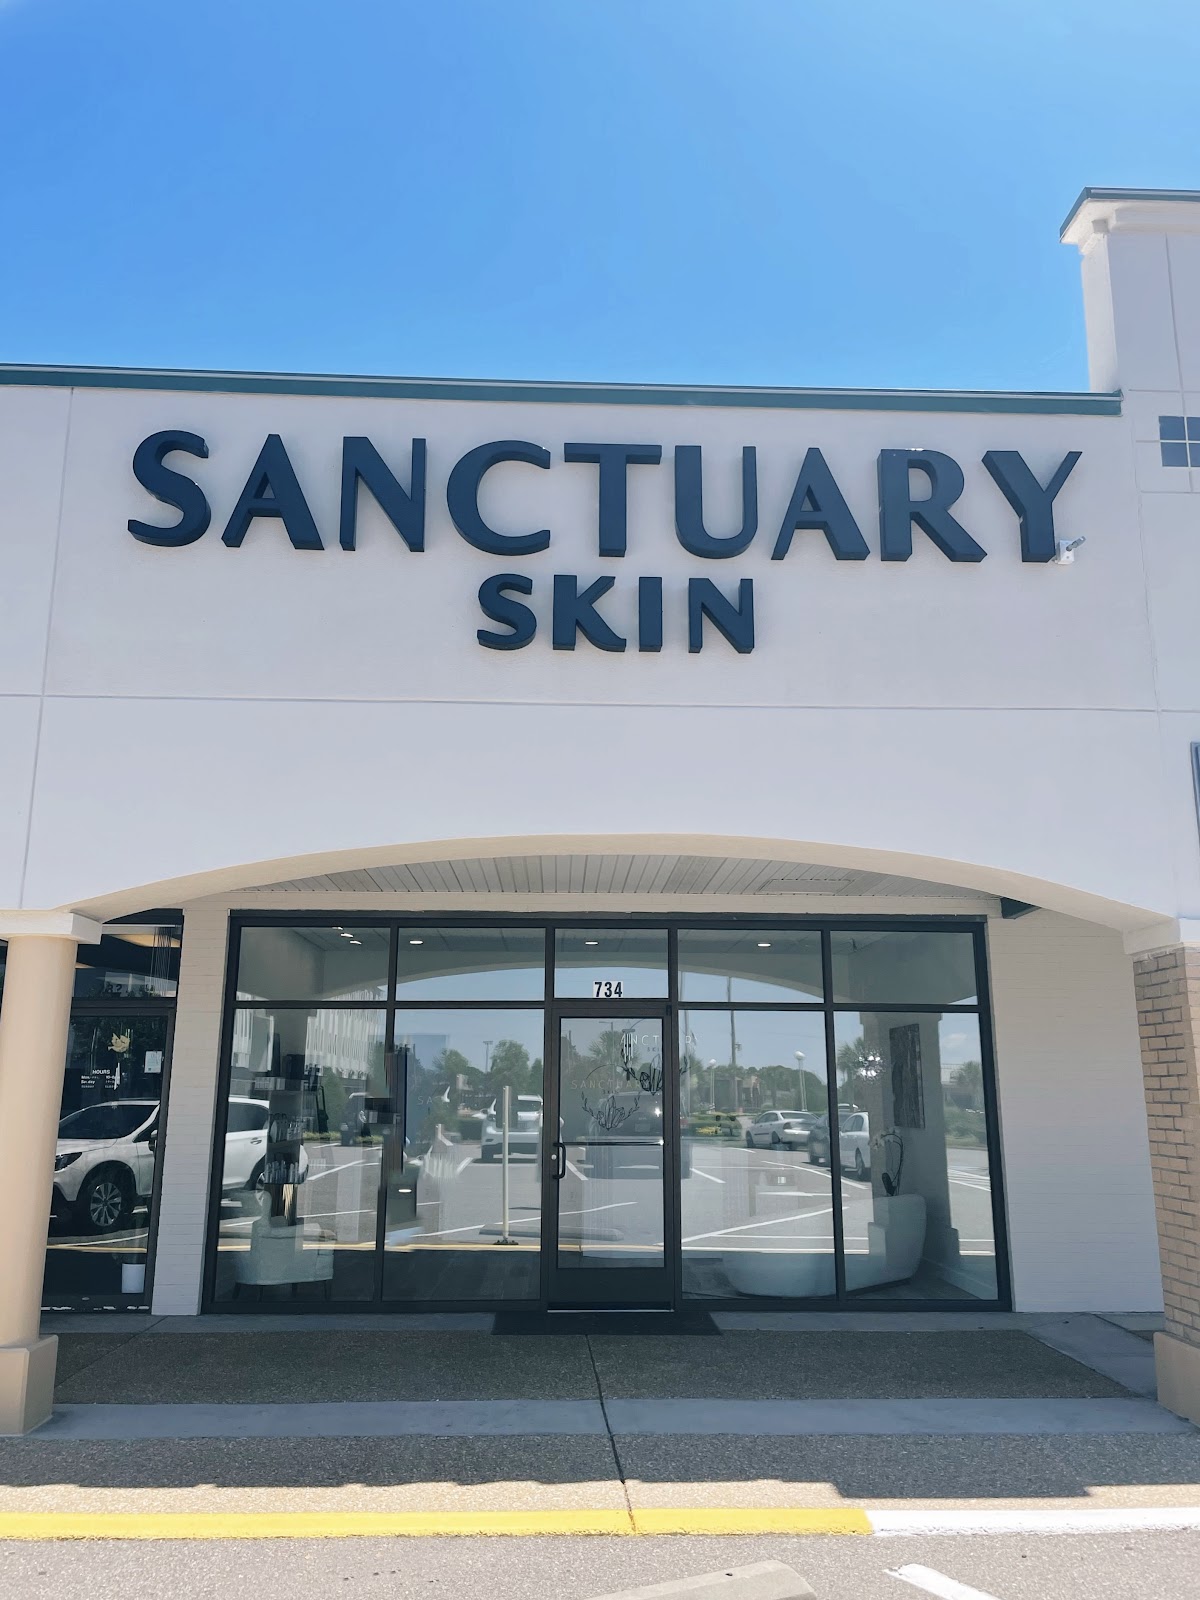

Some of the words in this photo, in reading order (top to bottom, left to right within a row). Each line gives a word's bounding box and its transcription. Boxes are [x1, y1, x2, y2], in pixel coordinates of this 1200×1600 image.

[128, 429, 1083, 563] SANCTUARY
[477, 573, 755, 654] SKIN
[594, 981, 623, 998] 734
